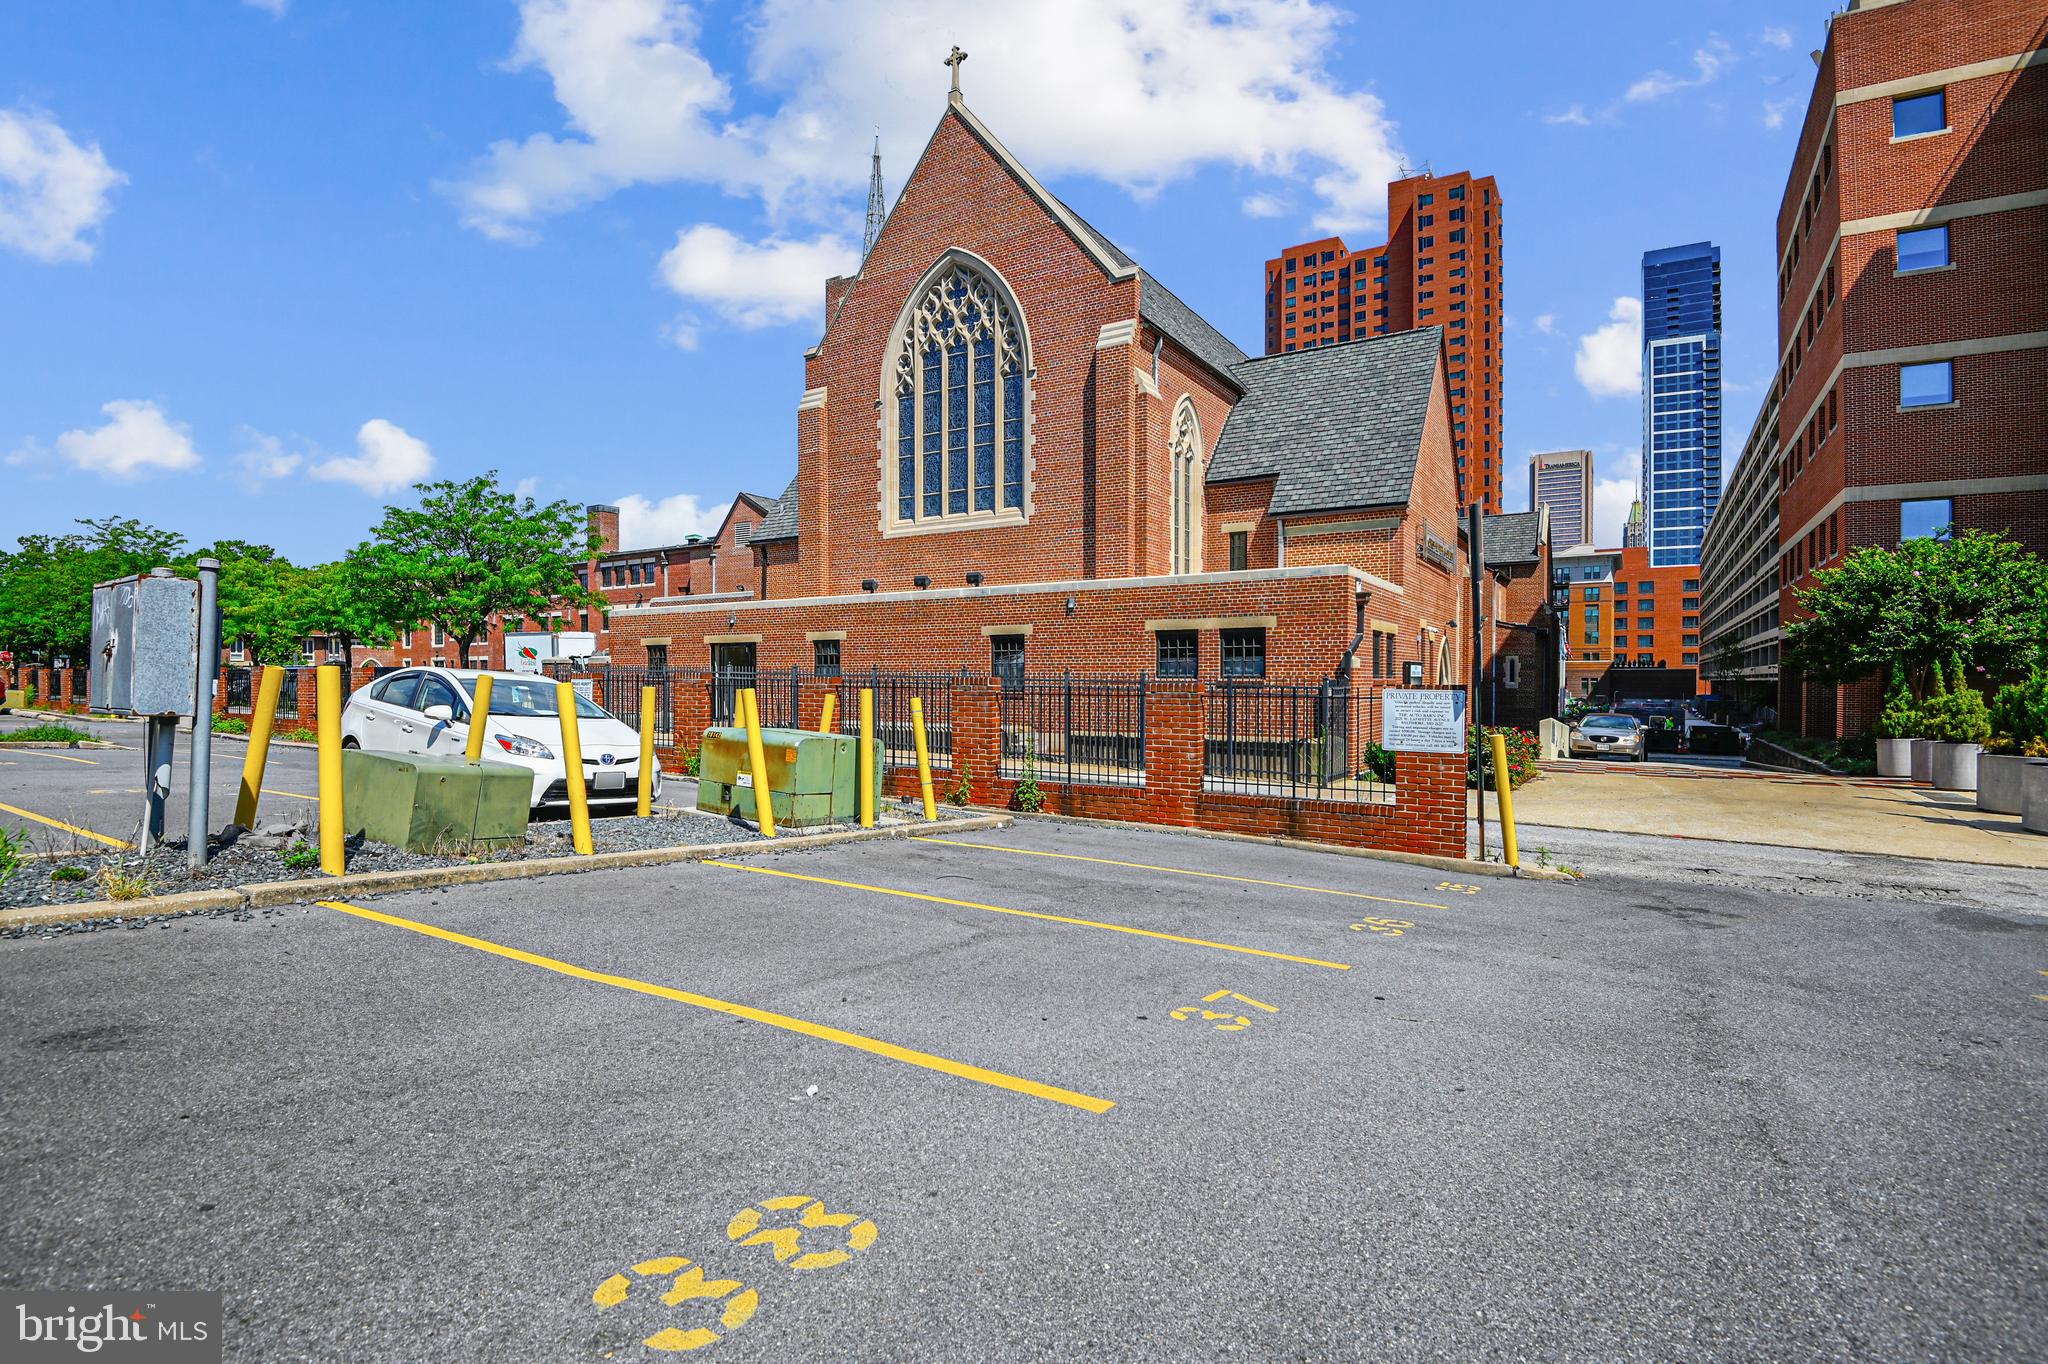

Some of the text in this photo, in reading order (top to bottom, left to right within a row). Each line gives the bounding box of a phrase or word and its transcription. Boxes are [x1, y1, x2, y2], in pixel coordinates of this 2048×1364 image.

[1544, 461, 1580, 470] TRANSAMERICA
[1386, 692, 1461, 701] PRIVATE PROPERTY
[1349, 916, 1415, 938] 36
[1169, 989, 1281, 1031] 37
[592, 1195, 878, 1351] 38
